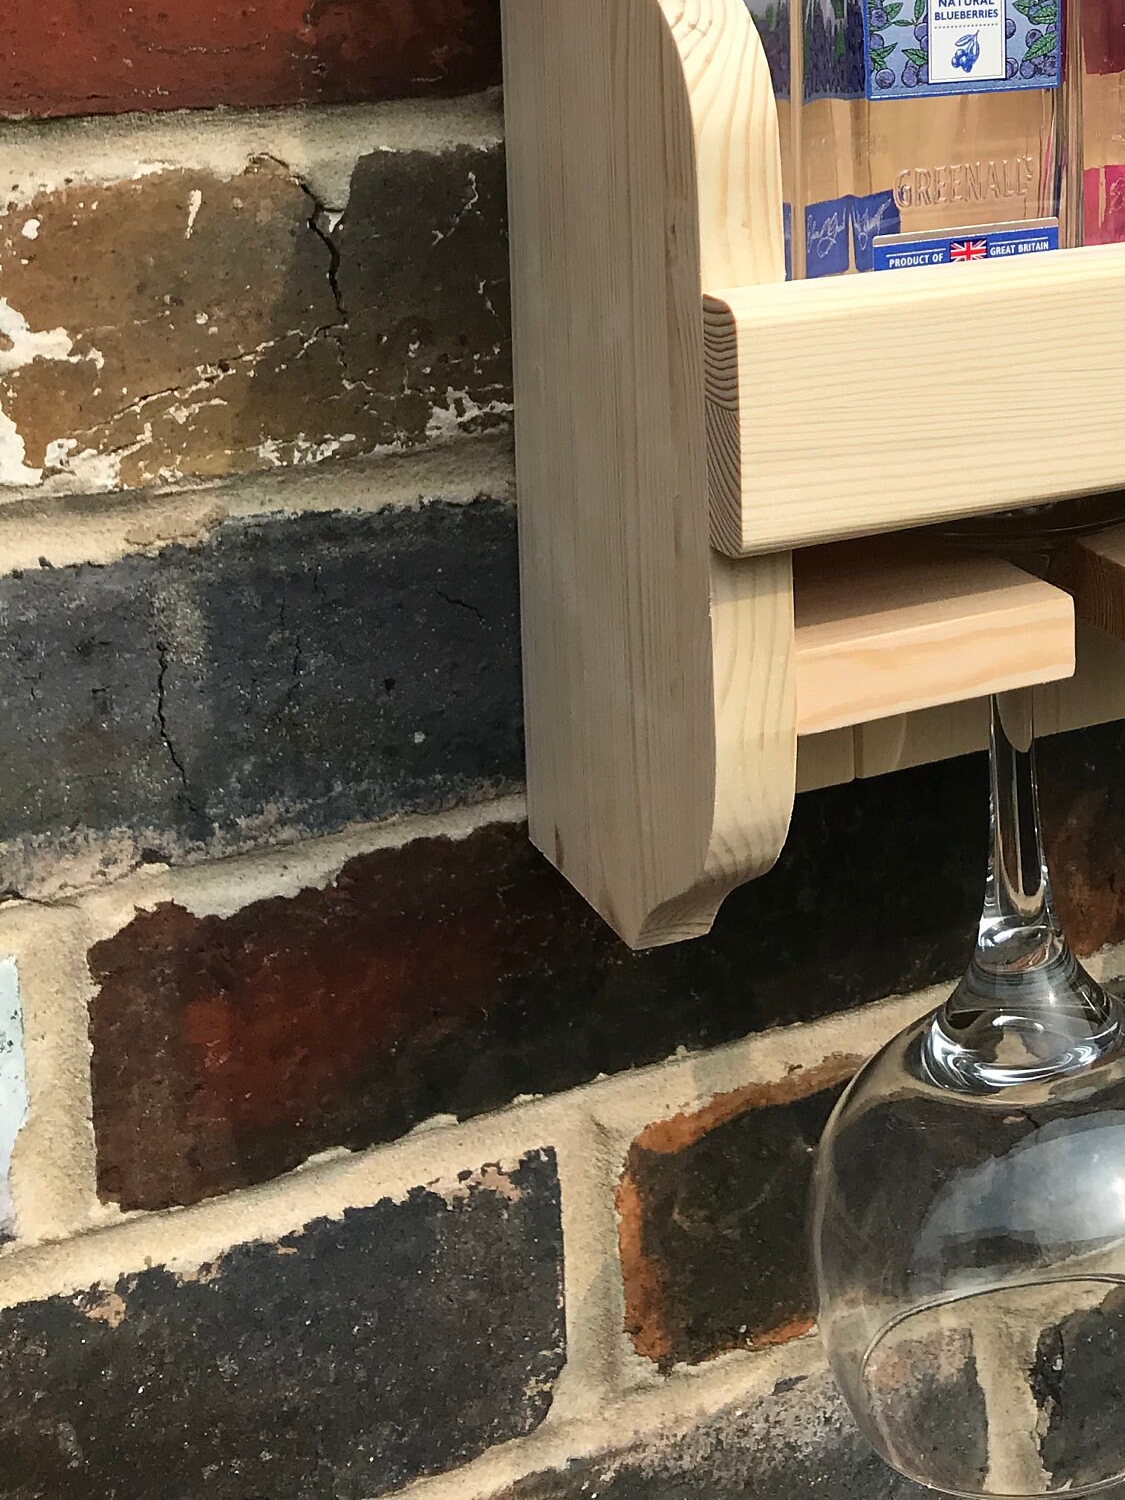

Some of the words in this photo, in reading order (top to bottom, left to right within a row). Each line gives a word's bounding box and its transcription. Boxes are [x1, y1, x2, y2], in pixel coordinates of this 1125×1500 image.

[934, 9, 999, 21] BLUEBERRIES
[888, 254, 929, 268] PRODUCT
[932, 252, 944, 263] OF
[989, 245, 1016, 256] GREAT
[1018, 241, 1049, 252] BRITAIN
